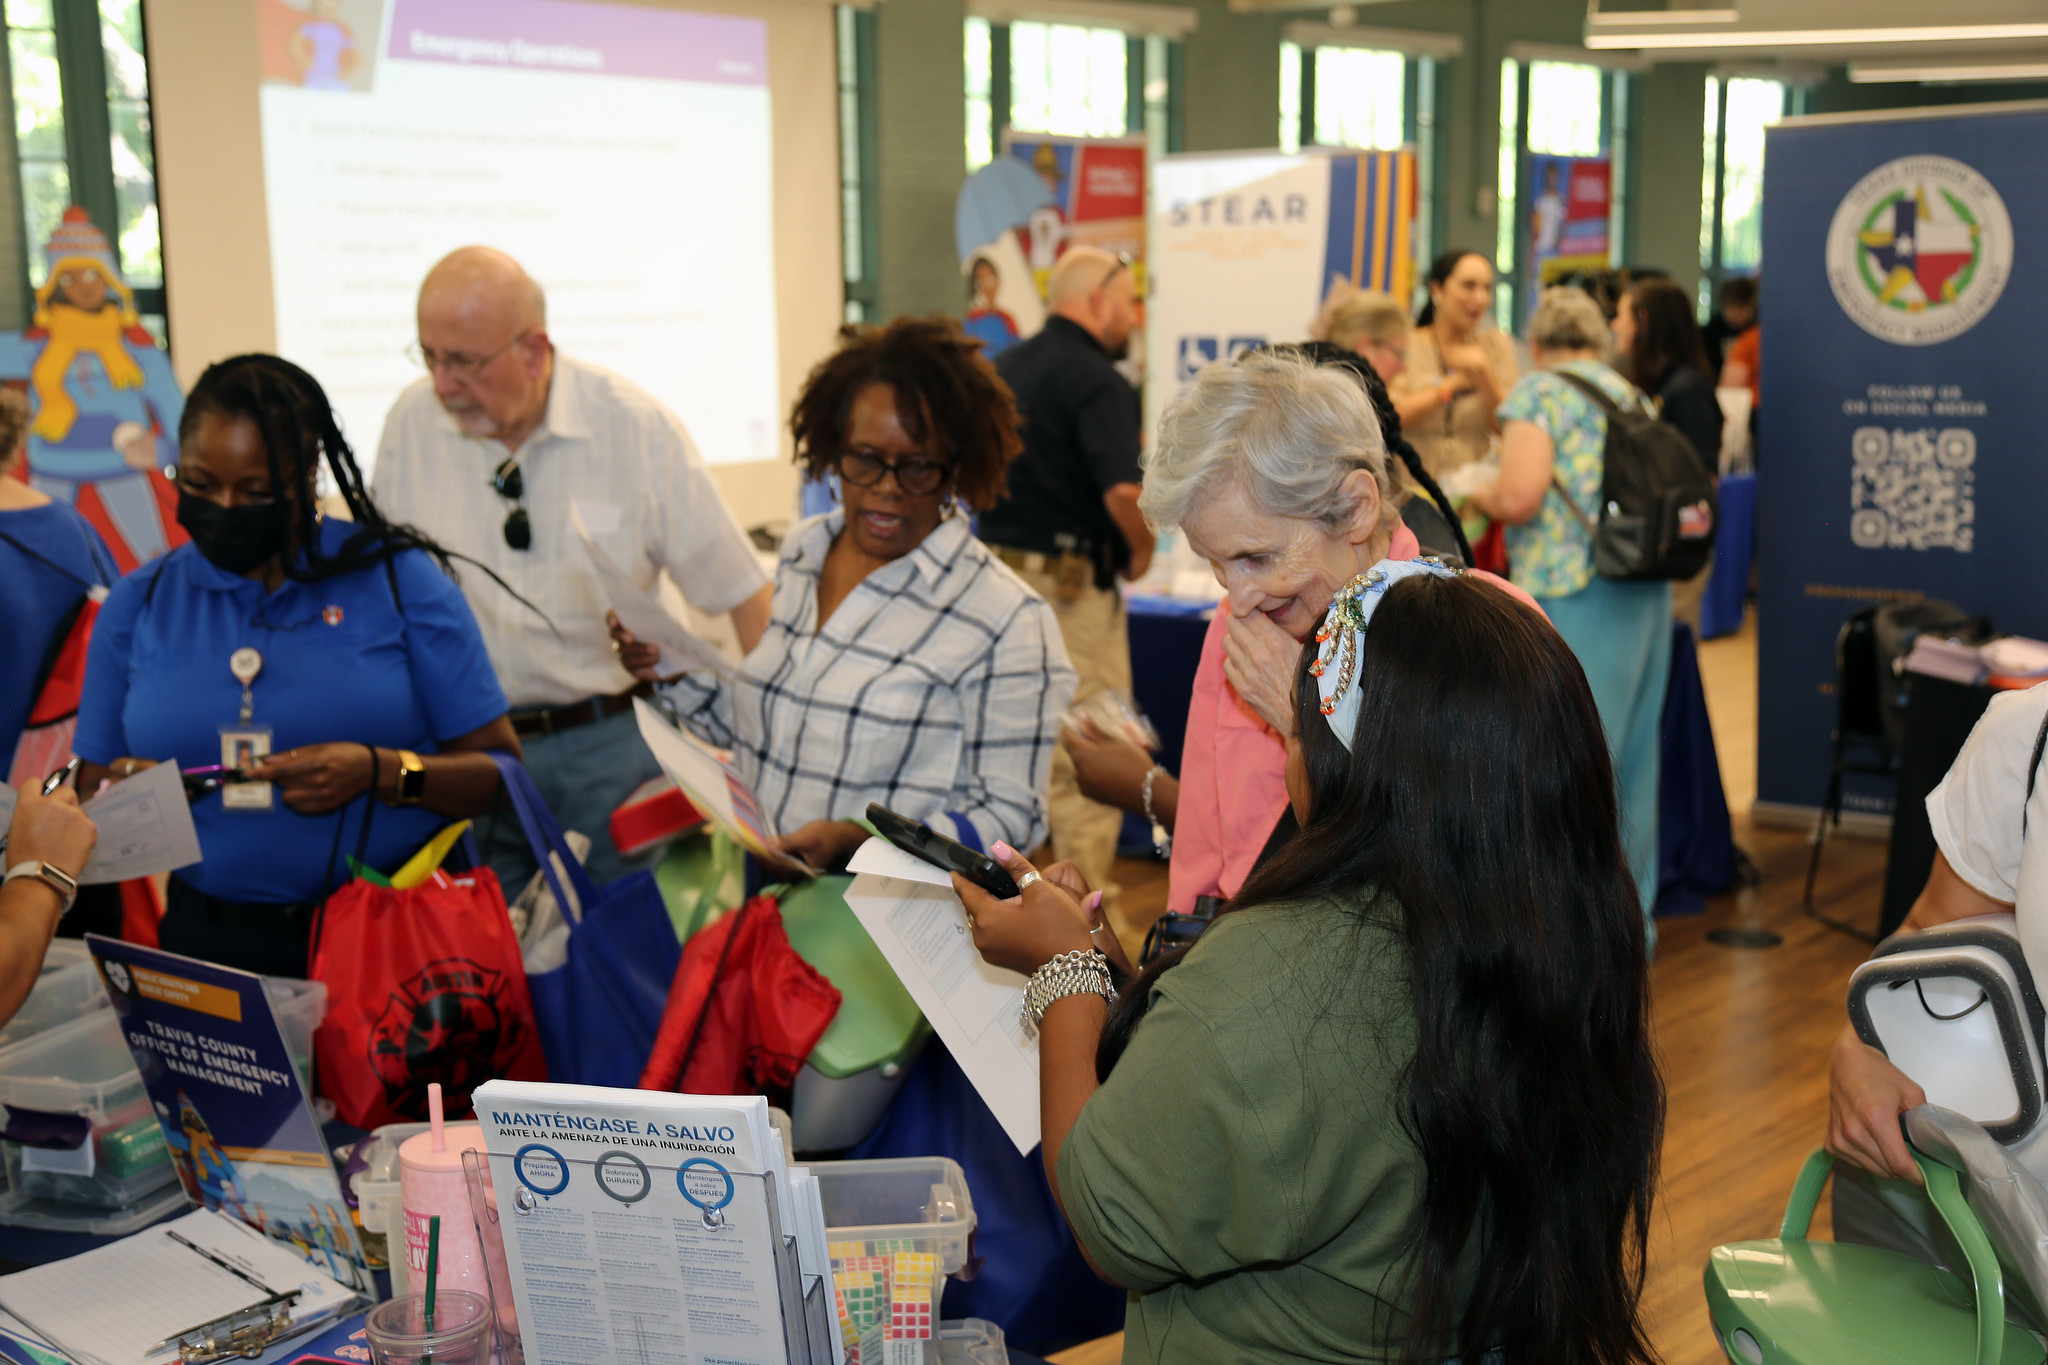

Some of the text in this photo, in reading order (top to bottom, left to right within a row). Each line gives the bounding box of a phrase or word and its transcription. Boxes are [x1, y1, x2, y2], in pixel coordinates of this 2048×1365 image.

[1169, 193, 1308, 228] STEAR
[421, 971, 484, 995] AUSTIN
[145, 1020, 257, 1063] TRAVIS COUNTY
[129, 1032, 290, 1088] OFFICE OF EMERGENCY
[165, 1058, 263, 1097] MANAGEMENT
[492, 1111, 735, 1141] MANTÉNGASE A SALVO
[500, 1128, 736, 1155] ANTE LA AMENAZA DE UNA INUNDACIÓN
[524, 1161, 558, 1170] Prepárese
[529, 1170, 555, 1178] AHORA
[605, 1168, 639, 1177] Sobreviva
[606, 1177, 641, 1185] DURANTE
[408, 1247, 429, 1271] LOV
